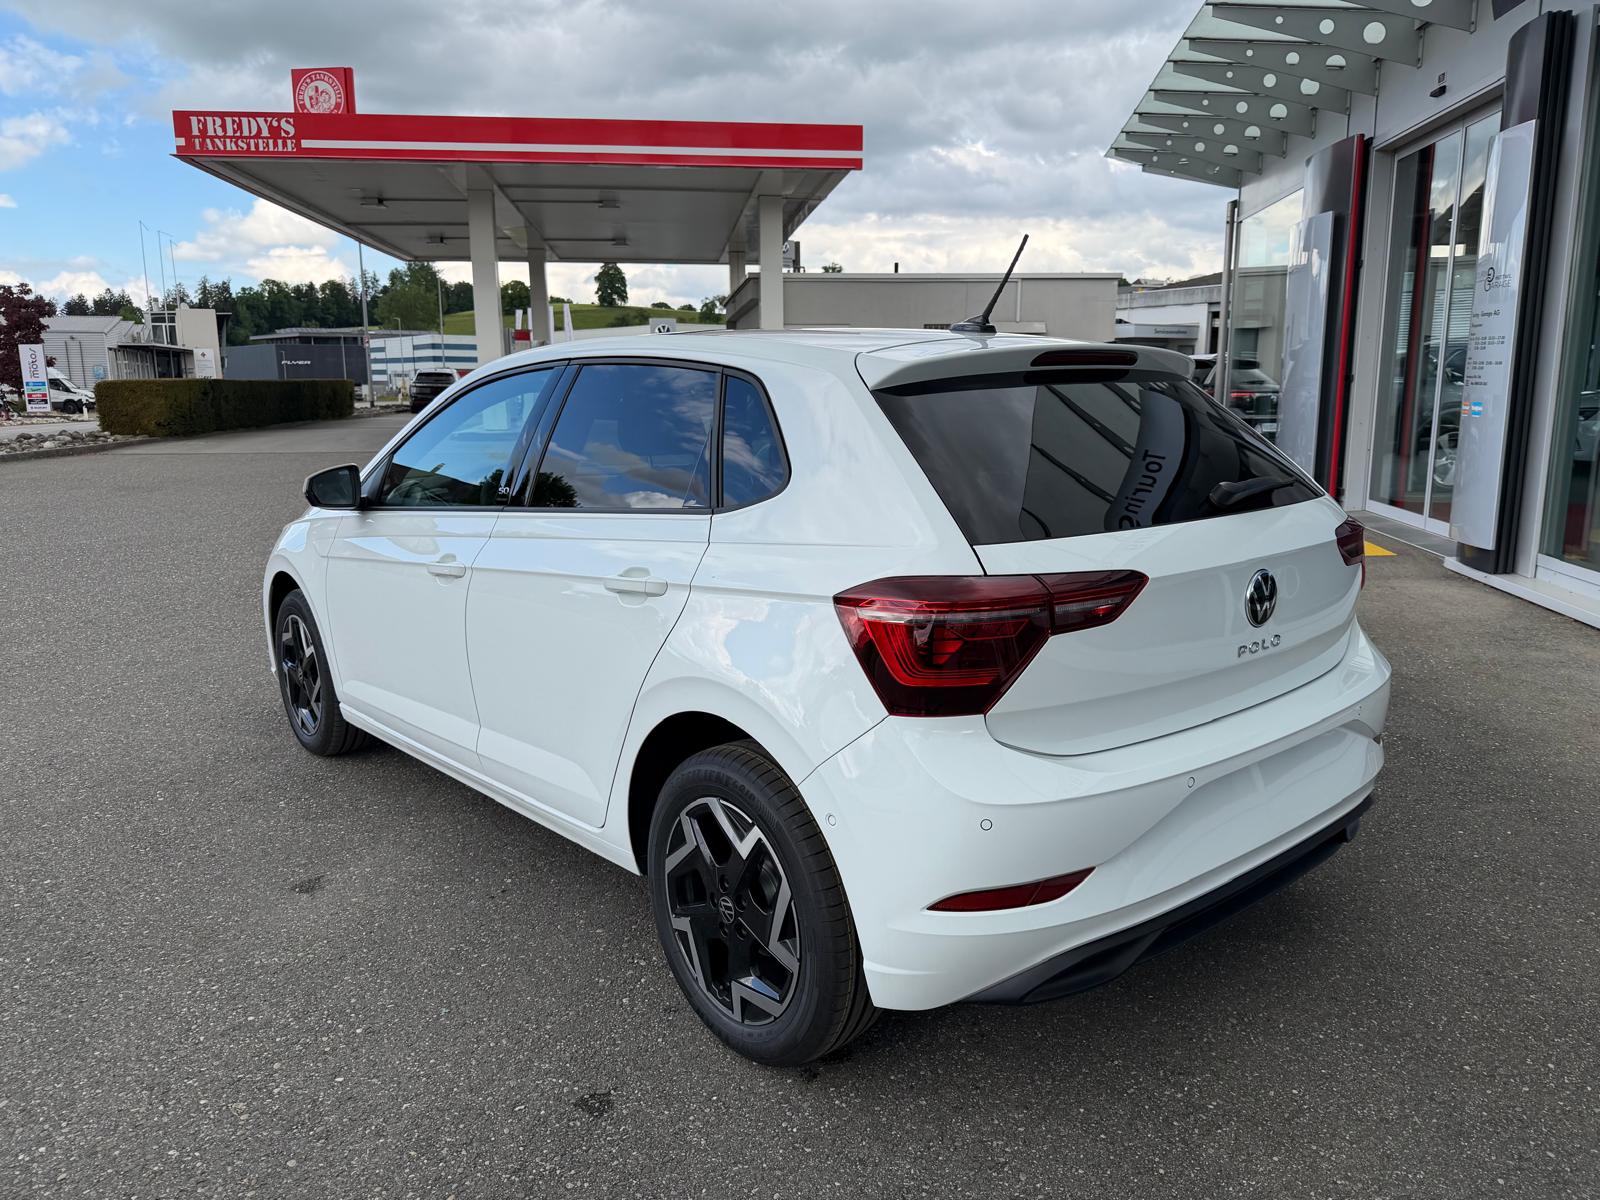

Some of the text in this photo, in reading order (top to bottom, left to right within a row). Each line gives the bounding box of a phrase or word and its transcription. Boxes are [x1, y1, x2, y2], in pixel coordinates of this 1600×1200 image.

[189, 116, 296, 137] FREDY'S
[192, 138, 297, 152] TANKSTELLE
[1237, 634, 1281, 658] POLO
